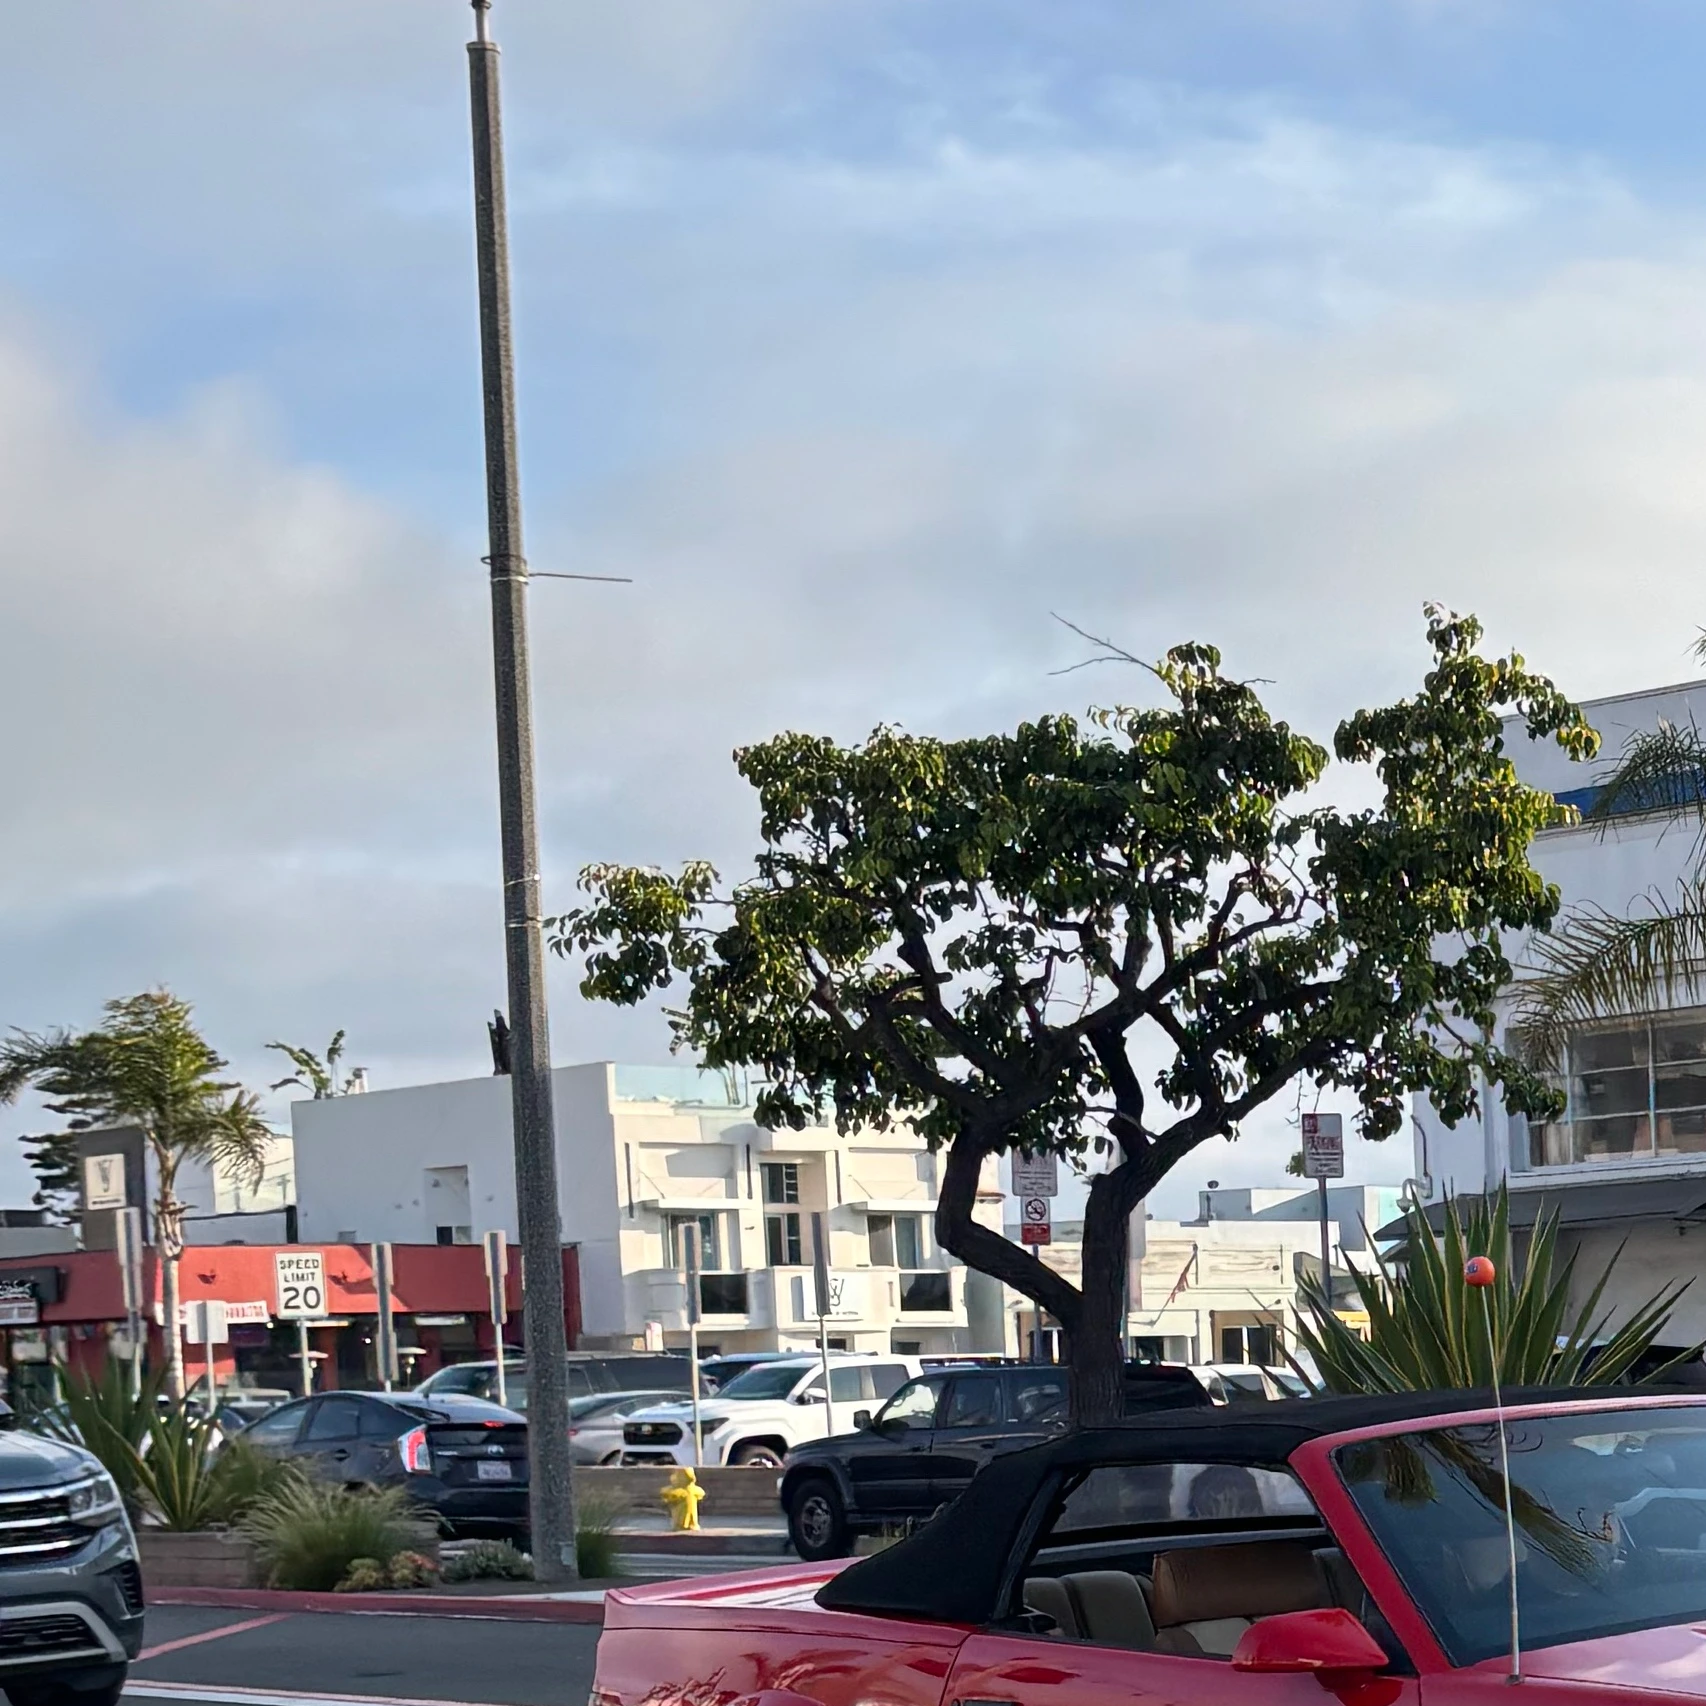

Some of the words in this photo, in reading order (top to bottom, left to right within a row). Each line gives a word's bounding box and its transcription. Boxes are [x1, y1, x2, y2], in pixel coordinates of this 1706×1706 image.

[279, 1258, 320, 1270] SPEED
[283, 1271, 316, 1283] LIMIT
[283, 1285, 321, 1310] 20
